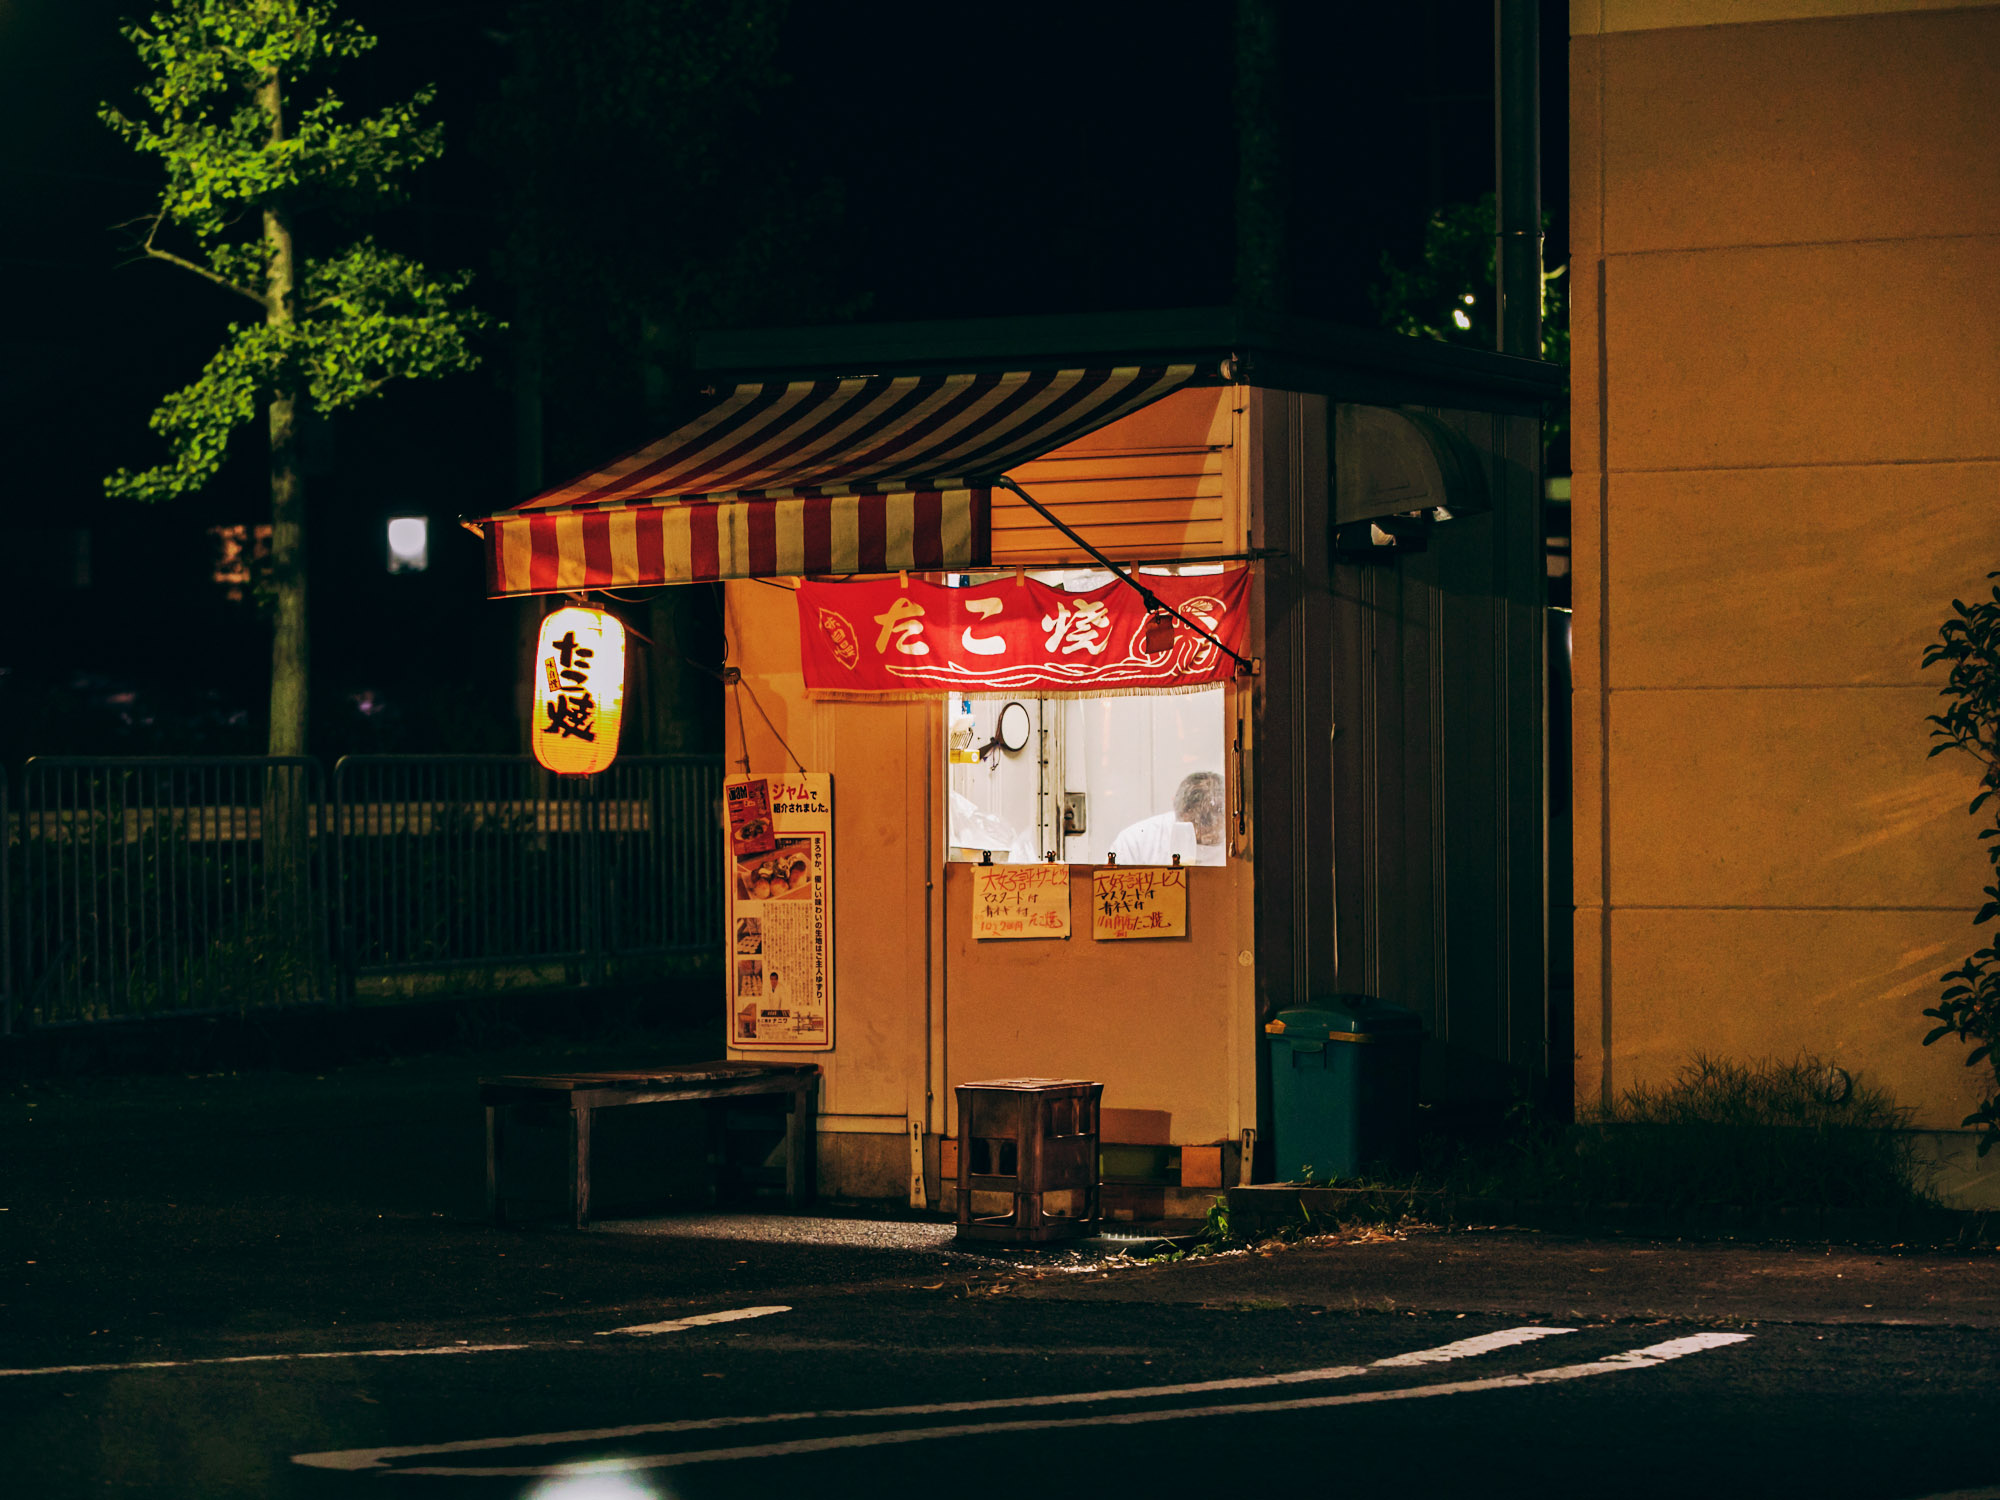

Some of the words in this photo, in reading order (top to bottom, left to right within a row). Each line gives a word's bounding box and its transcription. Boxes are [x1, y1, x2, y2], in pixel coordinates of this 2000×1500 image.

[824, 616, 856, 658] 味自慢
[873, 597, 1113, 656] たこ焼
[542, 630, 595, 743] たこ焼
[772, 783, 817, 801] ジャムで
[773, 802, 828, 813] 紹介されました。
